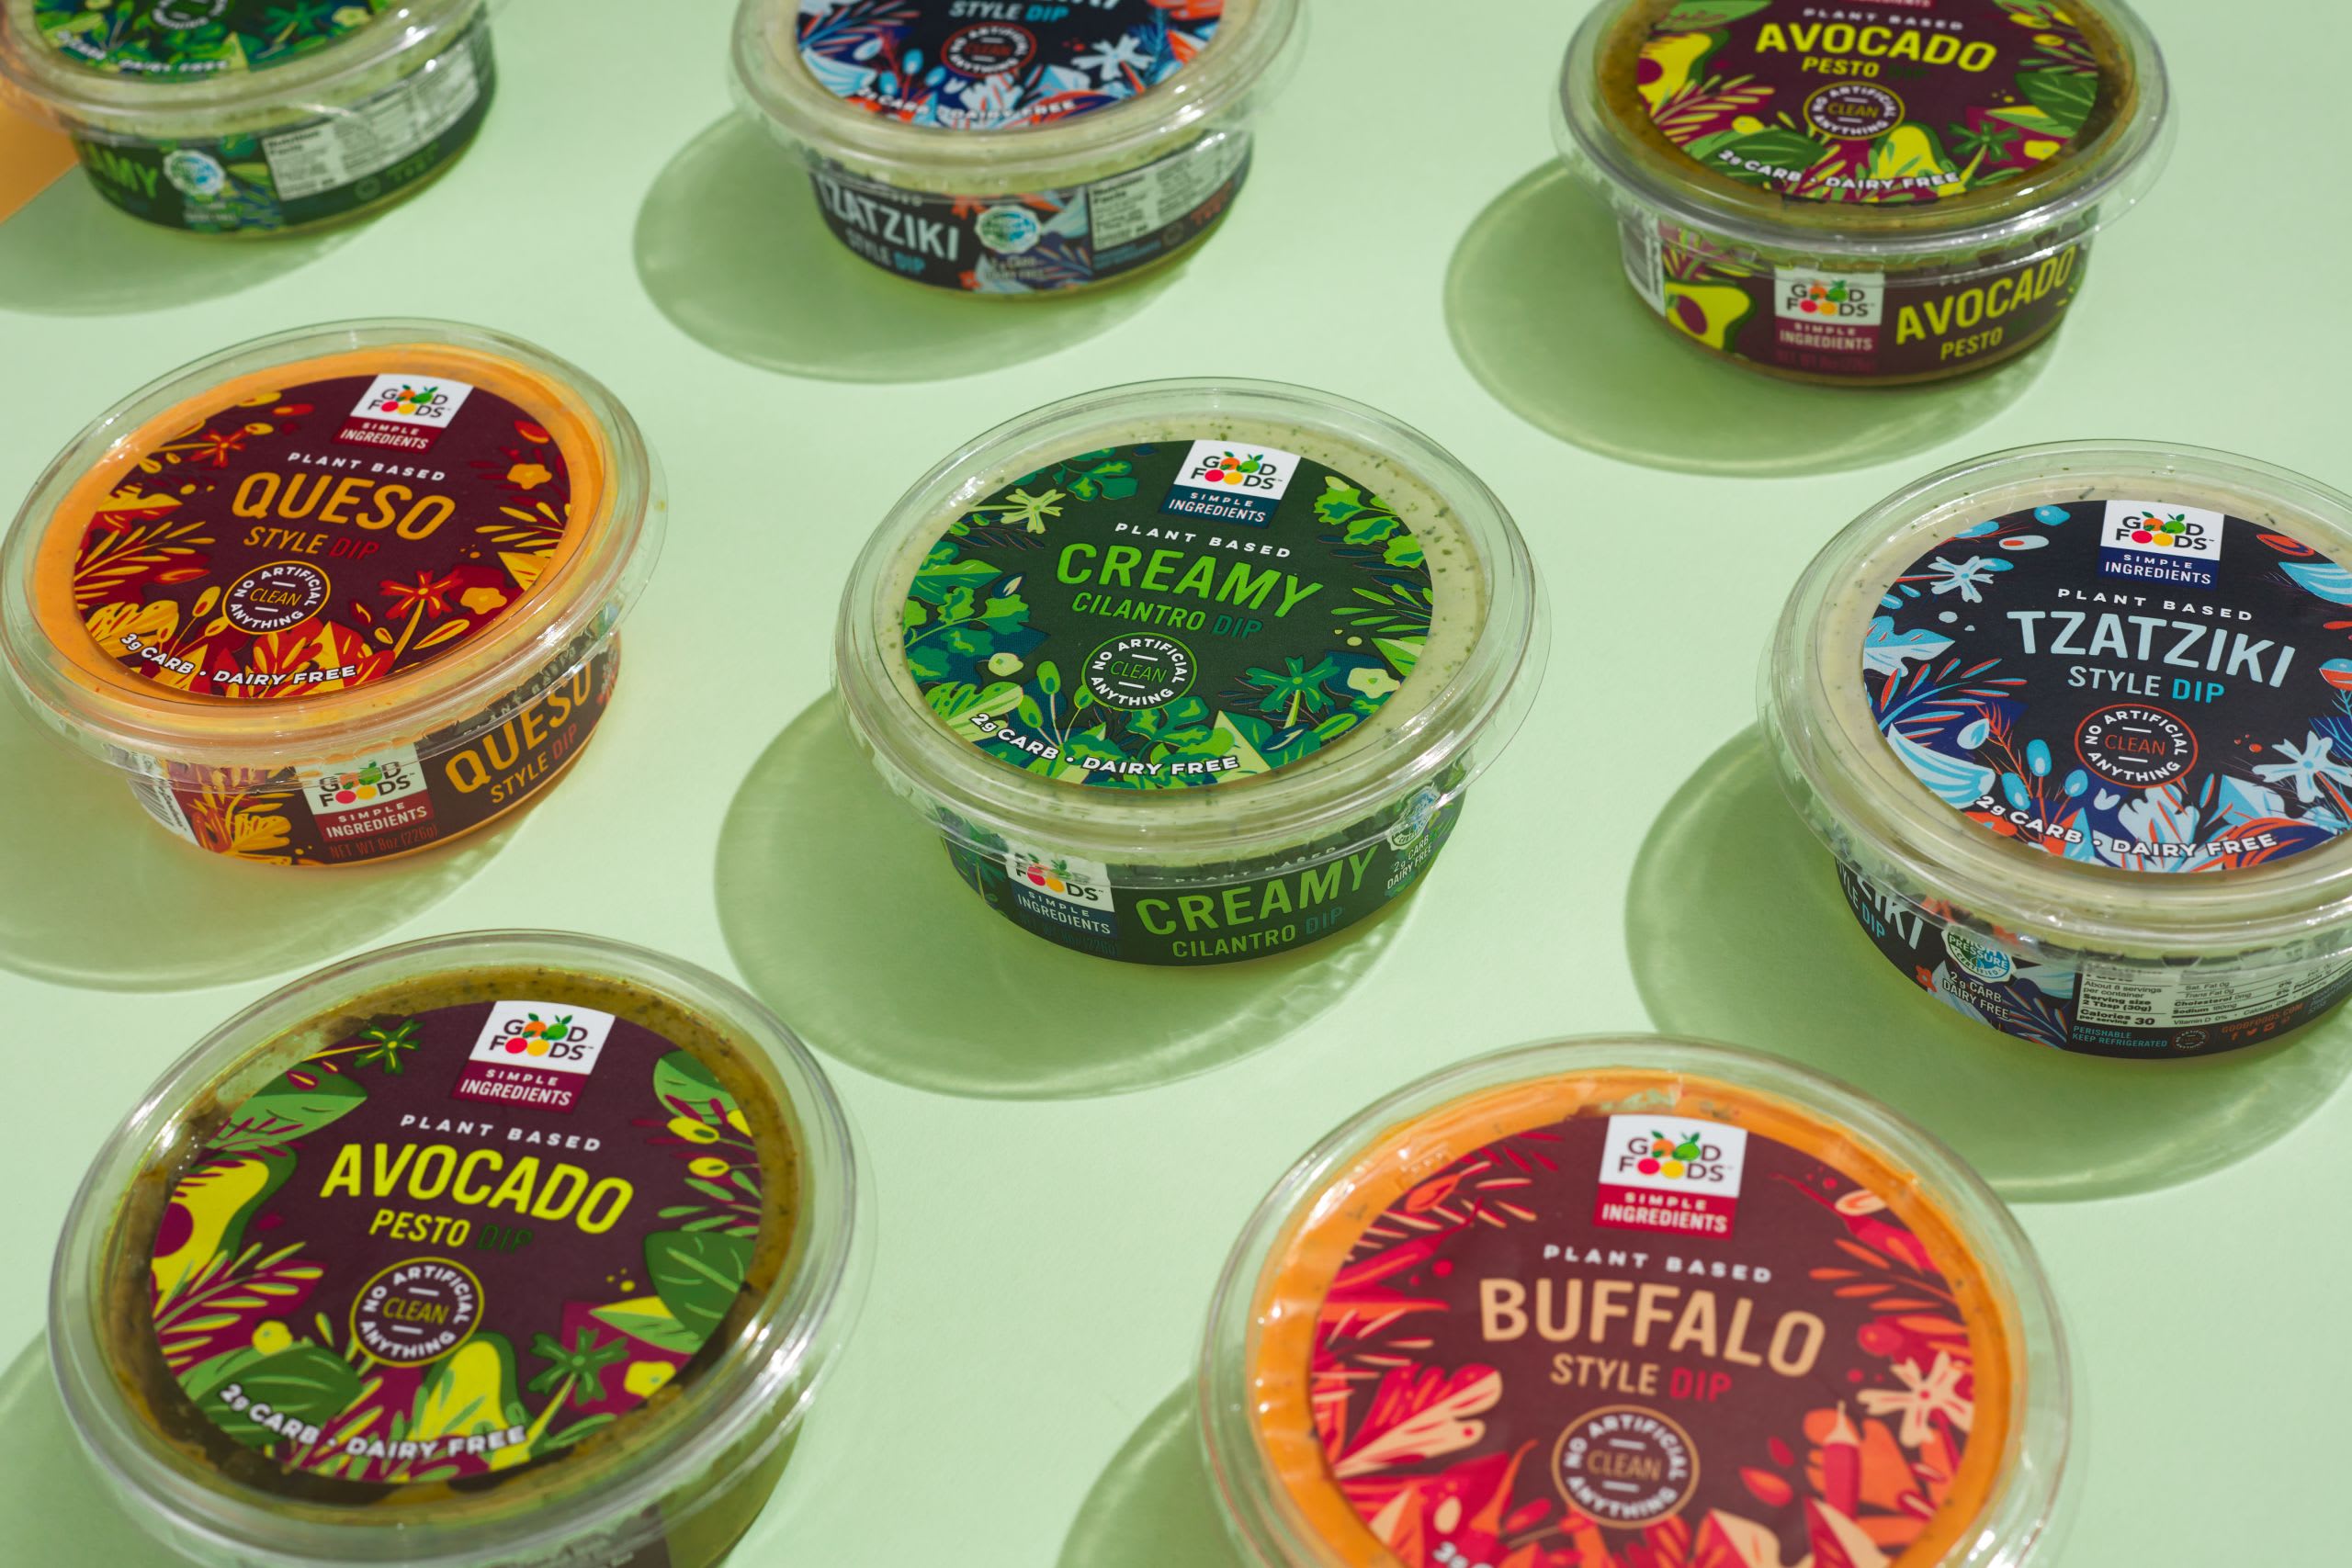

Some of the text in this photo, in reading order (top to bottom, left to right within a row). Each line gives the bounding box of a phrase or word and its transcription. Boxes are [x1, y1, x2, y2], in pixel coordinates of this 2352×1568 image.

[948, 2, 1069, 22] STYLE DIP
[1803, 7, 1963, 30] PLANT BASED
[1755, 22, 1998, 73] AVOCADO
[1802, 56, 1880, 78] PESTO
[1811, 85, 1897, 118] NO ARTIFICIAL
[1827, 102, 1880, 118] CLEAN
[1812, 114, 1889, 136] ANYTHING
[1745, 160, 1802, 183] CARB
[1825, 176, 1896, 190] DAIRY
[1902, 172, 1961, 189] FREE
[1786, 297, 1870, 317] FOODS
[1895, 244, 2077, 345] AVOCADO
[1779, 329, 1874, 351] INGREDIENTS
[1794, 321, 1857, 336] SIMPLE
[1940, 326, 2004, 361] PESTO
[368, 399, 445, 419] FOODS
[381, 383, 448, 406] GOOD
[340, 428, 429, 450] INGREDIENTS
[362, 422, 420, 435] SIMPLE
[288, 452, 446, 481] PLANT BASED
[1202, 451, 1277, 476] GOOD
[1191, 467, 1276, 491] FOODS
[232, 471, 457, 541] QUESO
[1169, 499, 1267, 523] INGREDIENTS
[1190, 492, 1254, 507] SIMPLE
[2122, 511, 2204, 536] GOOD
[243, 525, 380, 559] STYLE DIP
[1114, 523, 1292, 558] PLANT BASED
[2115, 528, 2207, 550] FOODS
[2105, 561, 2211, 585] INGREDIENTS
[2123, 554, 2193, 570] SIMPLE
[233, 566, 322, 607] NO ARTIFICIAL
[1057, 543, 1324, 618] CREAMY
[249, 588, 302, 607] CLEAN
[2058, 588, 2253, 621] PLANT BASED
[231, 603, 304, 629] ANYTHING
[1071, 592, 1263, 639] CILANTRO DIP
[1091, 638, 1188, 683] NO ARTIFICIAL
[2006, 611, 2296, 688] TZATZIKI
[141, 647, 195, 675] CARB
[212, 670, 288, 686] DAIRY
[292, 664, 358, 685] FREE
[1110, 660, 1168, 682] CLEAN
[1091, 676, 1174, 706] ANYTHING
[2067, 666, 2225, 704] STYLE DIP
[445, 660, 591, 794] QUESO
[2085, 710, 2188, 755] NO ARTIFICIAL
[997, 728, 1060, 760] CARB
[1082, 756, 1162, 775] DAIRY
[1171, 755, 1240, 776] FREE
[2104, 734, 2165, 756] CLEAN
[490, 722, 578, 804] STYLE DIP
[2087, 750, 2180, 783] ANYTHING
[319, 773, 412, 808] FOODS
[325, 806, 428, 840] INGREDIENTS
[337, 801, 405, 824] SIMPLE
[1408, 834, 1429, 861] CARB
[2009, 810, 2083, 844] CARB
[2111, 839, 2197, 858] DAIRY
[2207, 833, 2278, 857] FREE
[330, 842, 353, 860] NET
[1387, 841, 1432, 890] DAIRY FREE
[1028, 890, 1090, 918] SIMPLE
[1136, 844, 1378, 935] CREAMY
[1018, 893, 1111, 935] INGREDIENTS
[1861, 901, 1885, 939] DIP
[1172, 905, 1344, 958] CILANTRO DIP
[1949, 935, 2008, 971] PRESSURE
[1943, 979, 2009, 1020] DAIRY FREE
[1969, 981, 2002, 1003] CARB
[2083, 993, 2152, 1006] Serving size
[2084, 980, 2111, 990] About
[2123, 986, 2162, 994] servings
[2100, 989, 2144, 998] container
[2174, 996, 2233, 1007] Cholesterol
[2080, 1009, 2155, 1026] Calories 30
[2093, 1000, 2120, 1010] Tbsp
[2123, 1003, 2152, 1012] (30g)
[2096, 1017, 2128, 1025] serving
[2173, 1007, 2210, 1015] Sodium
[503, 1012, 589, 1043] GOOD
[2072, 1032, 2097, 1043] KEEP
[2098, 1037, 2168, 1047] REFRIGERATED
[2073, 1025, 2132, 1039] PERISHABLE
[488, 1034, 585, 1061] FOODS
[459, 1078, 572, 1107] INGREDIENTS
[485, 1068, 560, 1087] SIMPLE
[401, 1114, 602, 1153] PLANT BASED
[1628, 1130, 1722, 1163] GOOD
[1618, 1156, 1724, 1182] FOODS
[319, 1143, 635, 1235] AVOCADO
[1623, 1191, 1707, 1212] SIMPLE
[368, 1208, 535, 1255] PESTO DIP
[1601, 1203, 1728, 1234] INGREDIENTS
[1544, 1244, 1772, 1283] PLANT BASED
[362, 1265, 474, 1324] NO ARTIFICIAL
[382, 1296, 450, 1325] CLEAN
[359, 1320, 457, 1359] ANYTHING
[1479, 1278, 1826, 1377] BUFFALO
[1549, 1353, 1733, 1403] STYLE DIP
[249, 1403, 322, 1445] CARB
[345, 1437, 440, 1460] DAIRY
[447, 1424, 528, 1457] FREE
[1565, 1414, 1688, 1481] NO ARTIFICIAL
[1587, 1450, 1662, 1481] CLEAN
[1566, 1475, 1678, 1518] ANYTHING
